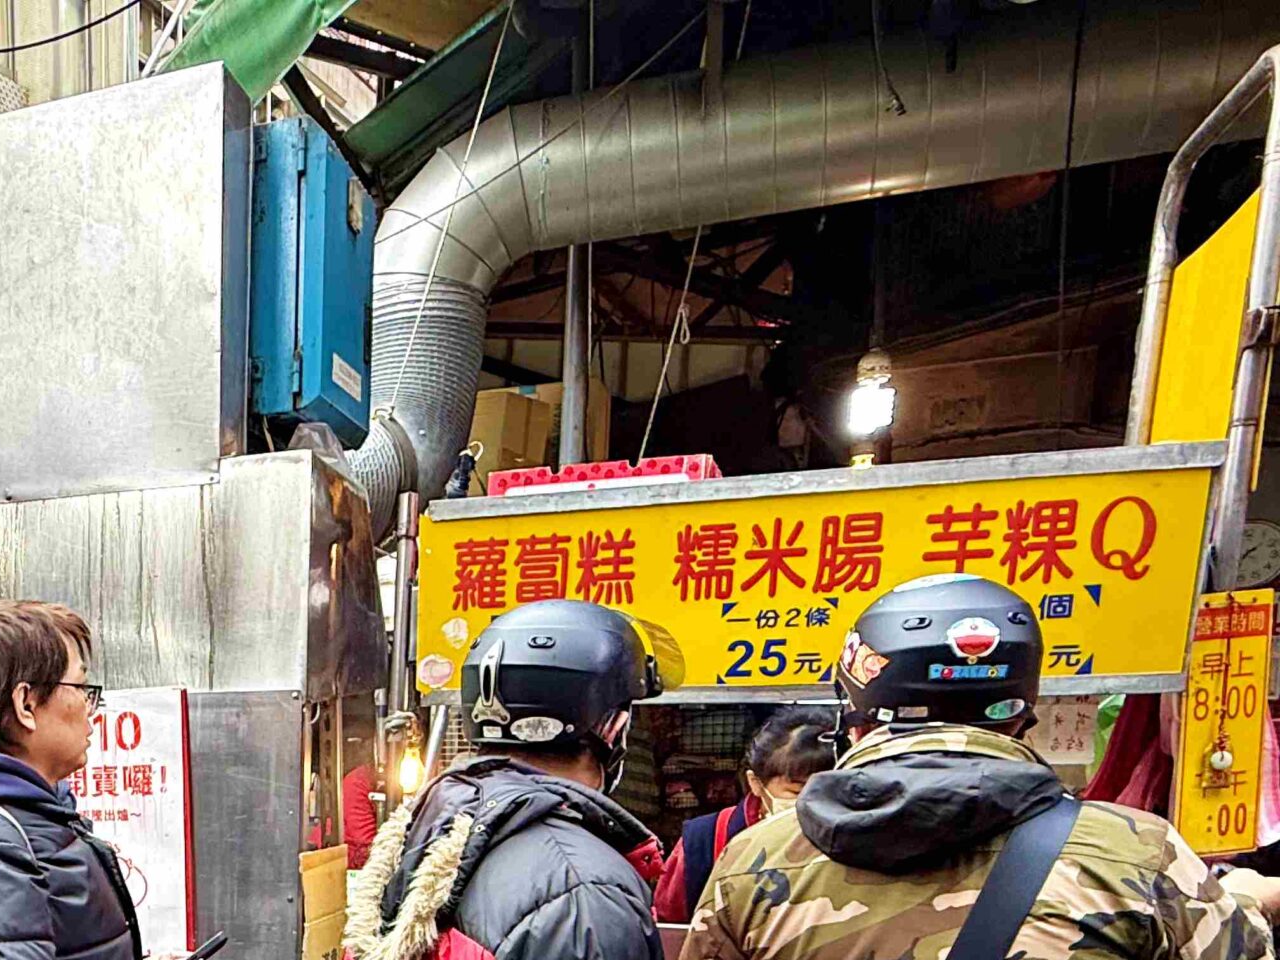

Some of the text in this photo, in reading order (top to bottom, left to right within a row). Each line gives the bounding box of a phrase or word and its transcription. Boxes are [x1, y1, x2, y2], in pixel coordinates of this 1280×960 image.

[451, 496, 1158, 611] 蘿蔔糕 糯米腸 芋粿Q
[726, 607, 830, 629] 一份2條
[1038, 593, 1074, 621] 個
[1195, 611, 1265, 635] 營業時間
[724, 639, 822, 678] 25元
[1048, 644, 1082, 668] 元
[1200, 650, 1254, 680] 早上
[1194, 685, 1257, 721] 8:00
